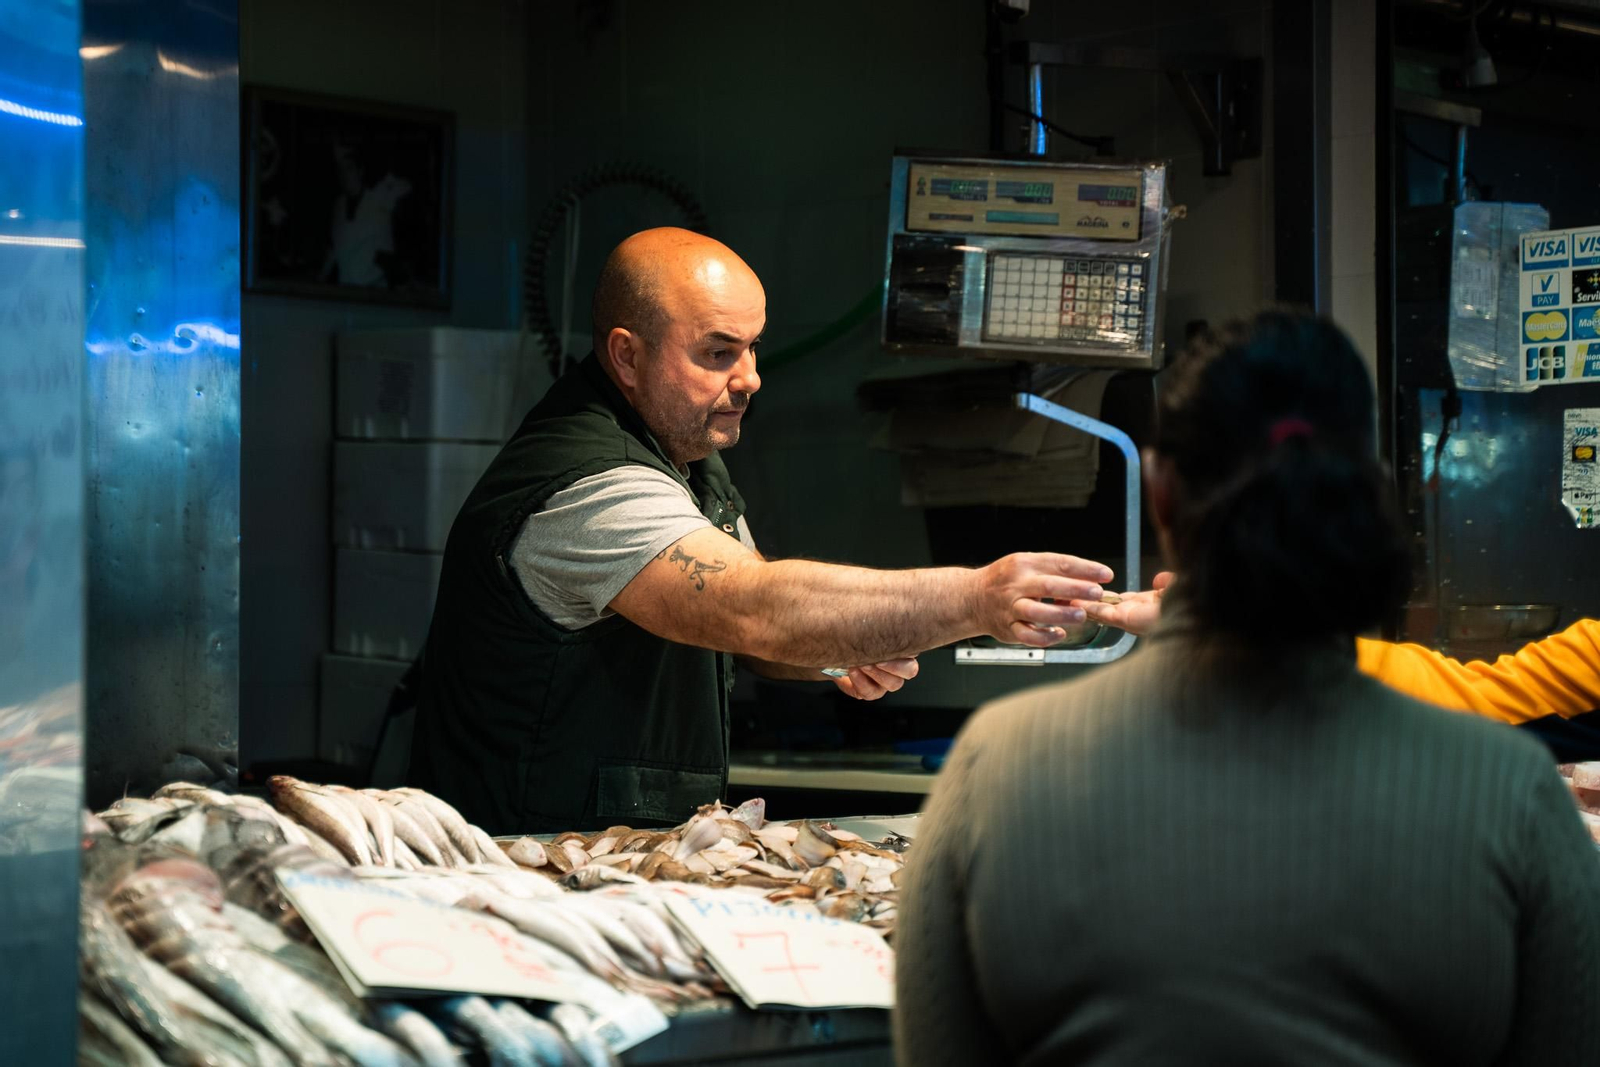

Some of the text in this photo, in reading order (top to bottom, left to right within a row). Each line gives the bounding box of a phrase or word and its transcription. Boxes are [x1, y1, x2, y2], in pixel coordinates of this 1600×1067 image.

[1529, 239, 1566, 257] VISA
[1537, 295, 1554, 306] PAY
[1526, 356, 1565, 371] JCB
[1575, 426, 1598, 438] VISA
[1581, 492, 1593, 501] Pay
[352, 907, 455, 978] 6
[731, 930, 821, 1003] 7
